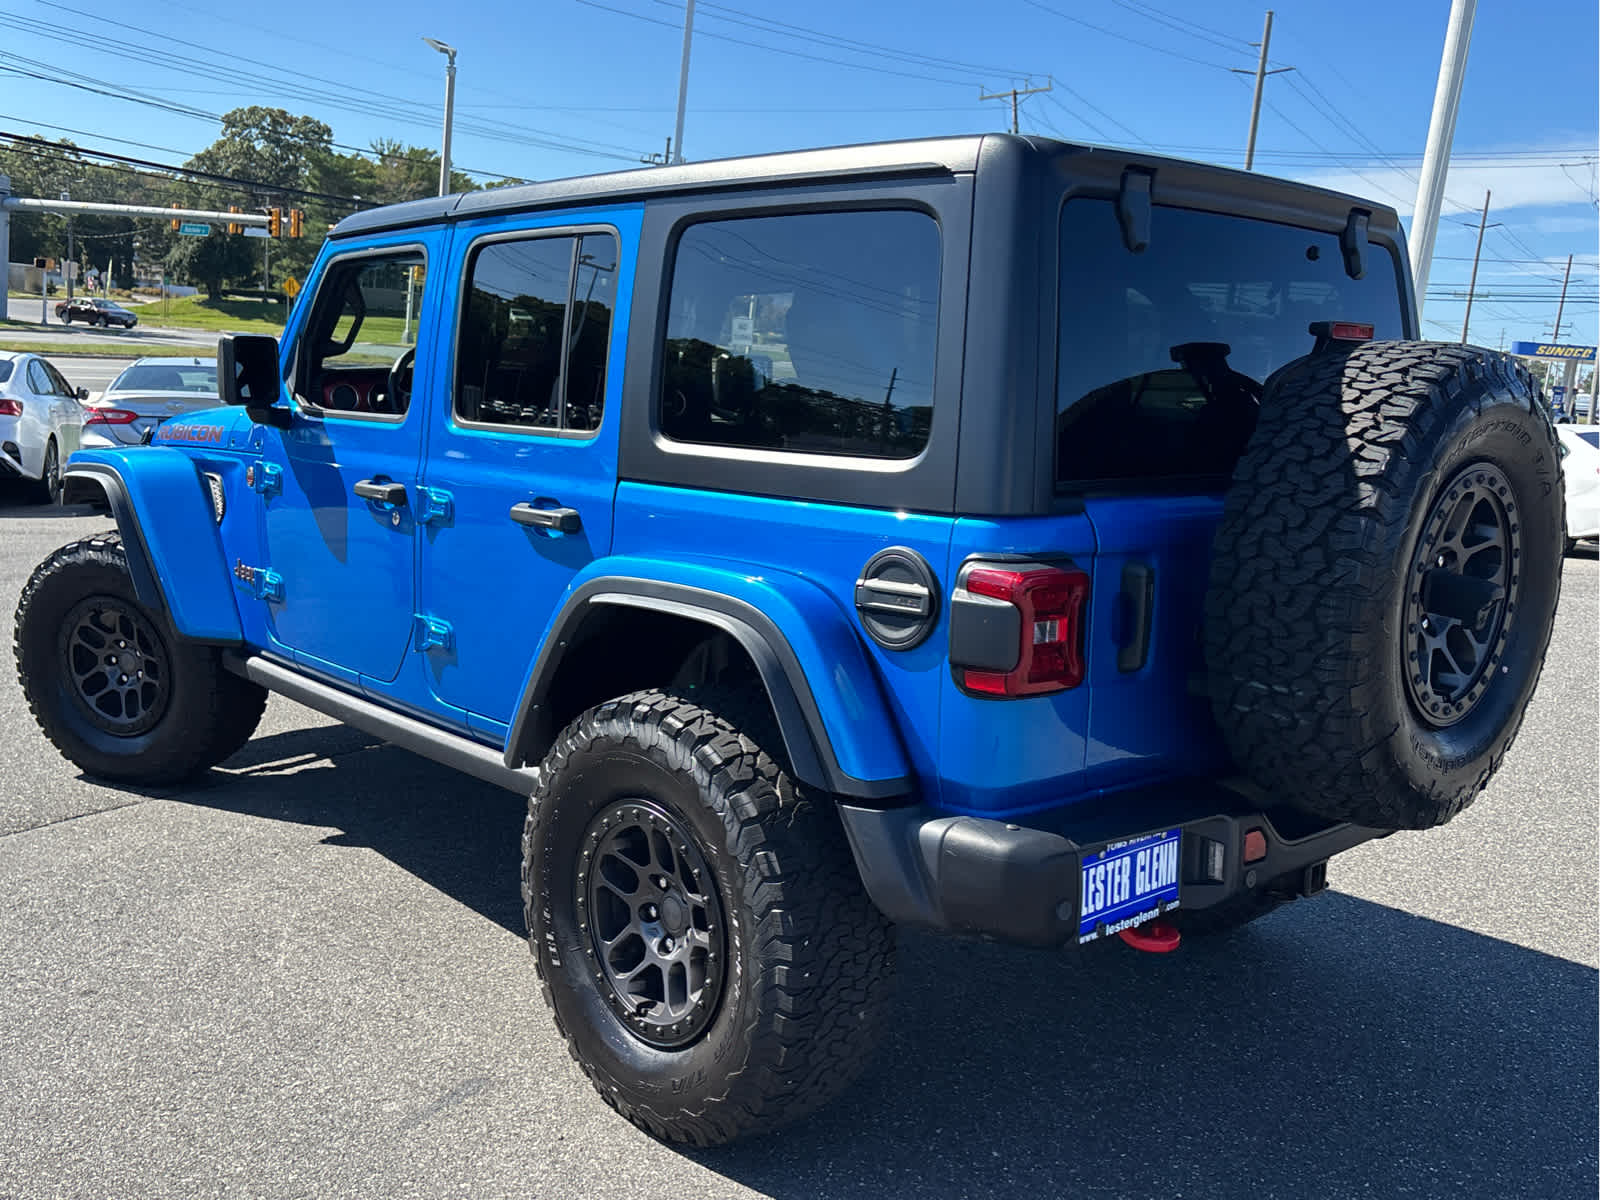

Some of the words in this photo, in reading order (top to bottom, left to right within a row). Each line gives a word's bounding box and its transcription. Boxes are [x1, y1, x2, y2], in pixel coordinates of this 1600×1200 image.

[1536, 345, 1593, 358] SUNOCO
[155, 424, 225, 443] RUBICON
[234, 557, 255, 584] Jeep
[1081, 855, 1132, 917] LESTER
[1135, 839, 1178, 896] GLENN
